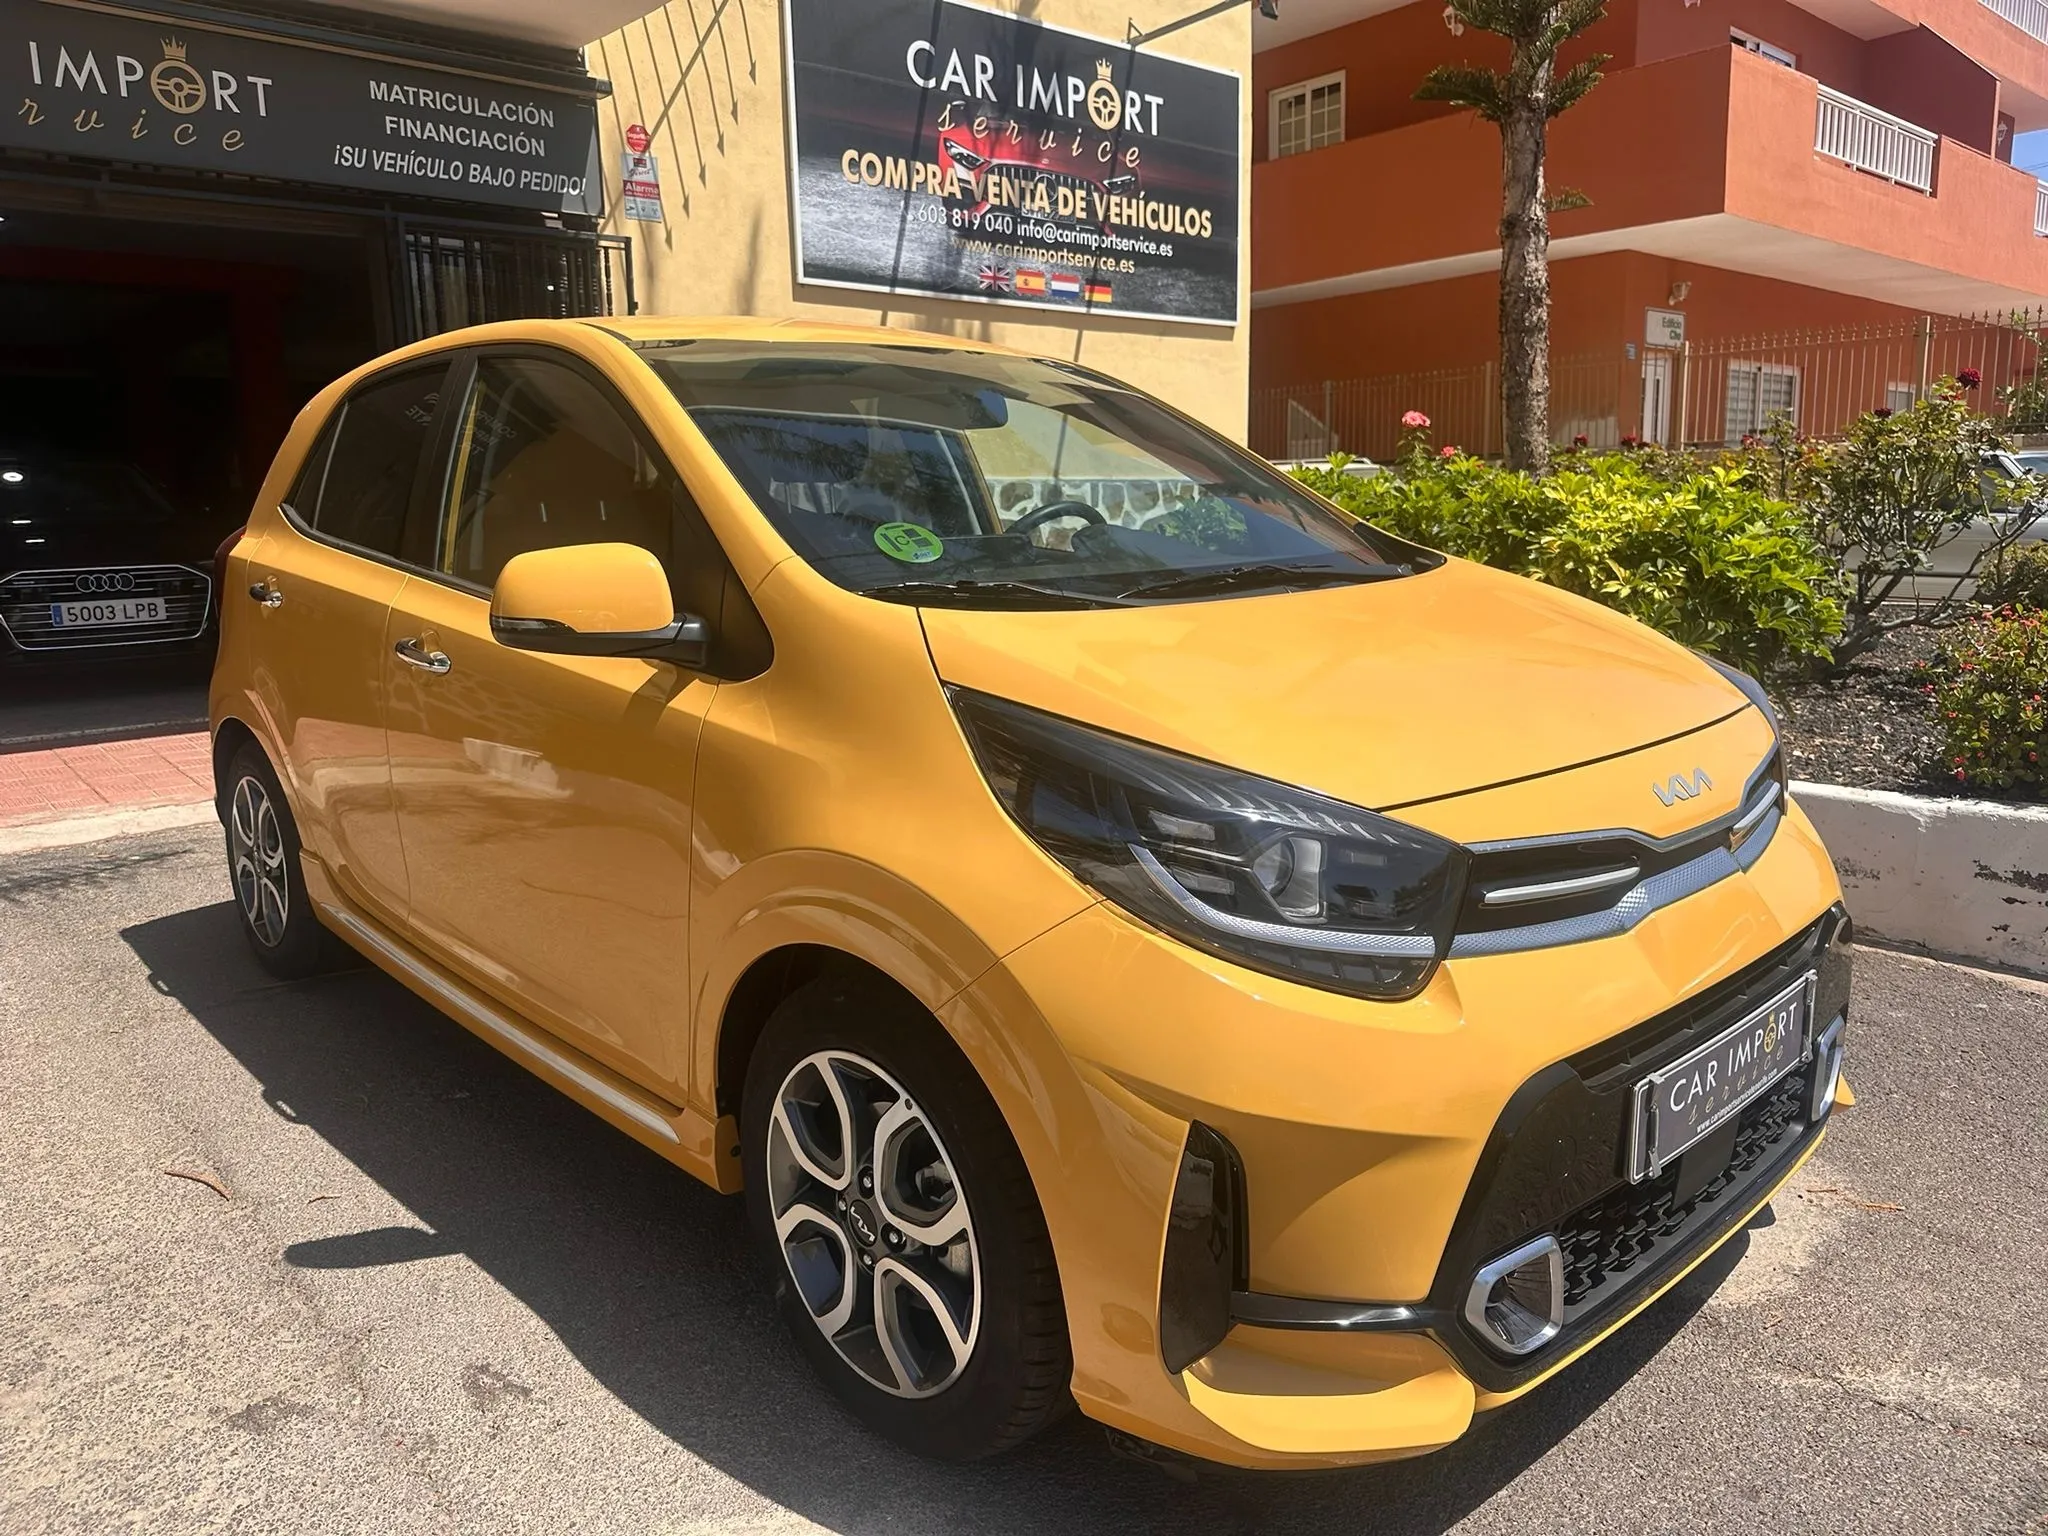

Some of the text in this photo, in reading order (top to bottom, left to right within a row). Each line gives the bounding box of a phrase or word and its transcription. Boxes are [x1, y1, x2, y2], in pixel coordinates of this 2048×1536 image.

[29, 41, 272, 117] IMPORT
[369, 80, 554, 128] MATRICULACIÓN
[907, 40, 1165, 136] CAR IMPORT
[385, 115, 545, 157] FINANCIACIÓN
[938, 101, 1140, 168] service
[334, 145, 586, 196] ¡SU VEHÍCULO BAJO PEDIDO!
[625, 182, 659, 194] Alarma
[841, 149, 963, 200] COMPRA
[970, 173, 1050, 213] VENTA
[1057, 187, 1087, 220] DE
[1092, 190, 1213, 239] VEHÍCULOS
[918, 204, 1173, 257] 603 819 040 info@carimportservice.es
[952, 236, 1135, 274] www.carimportservice.es
[67, 602, 159, 623] 5003 LPB
[1670, 1002, 1797, 1112] CAR IMPORT
[1689, 1045, 1783, 1125] service
